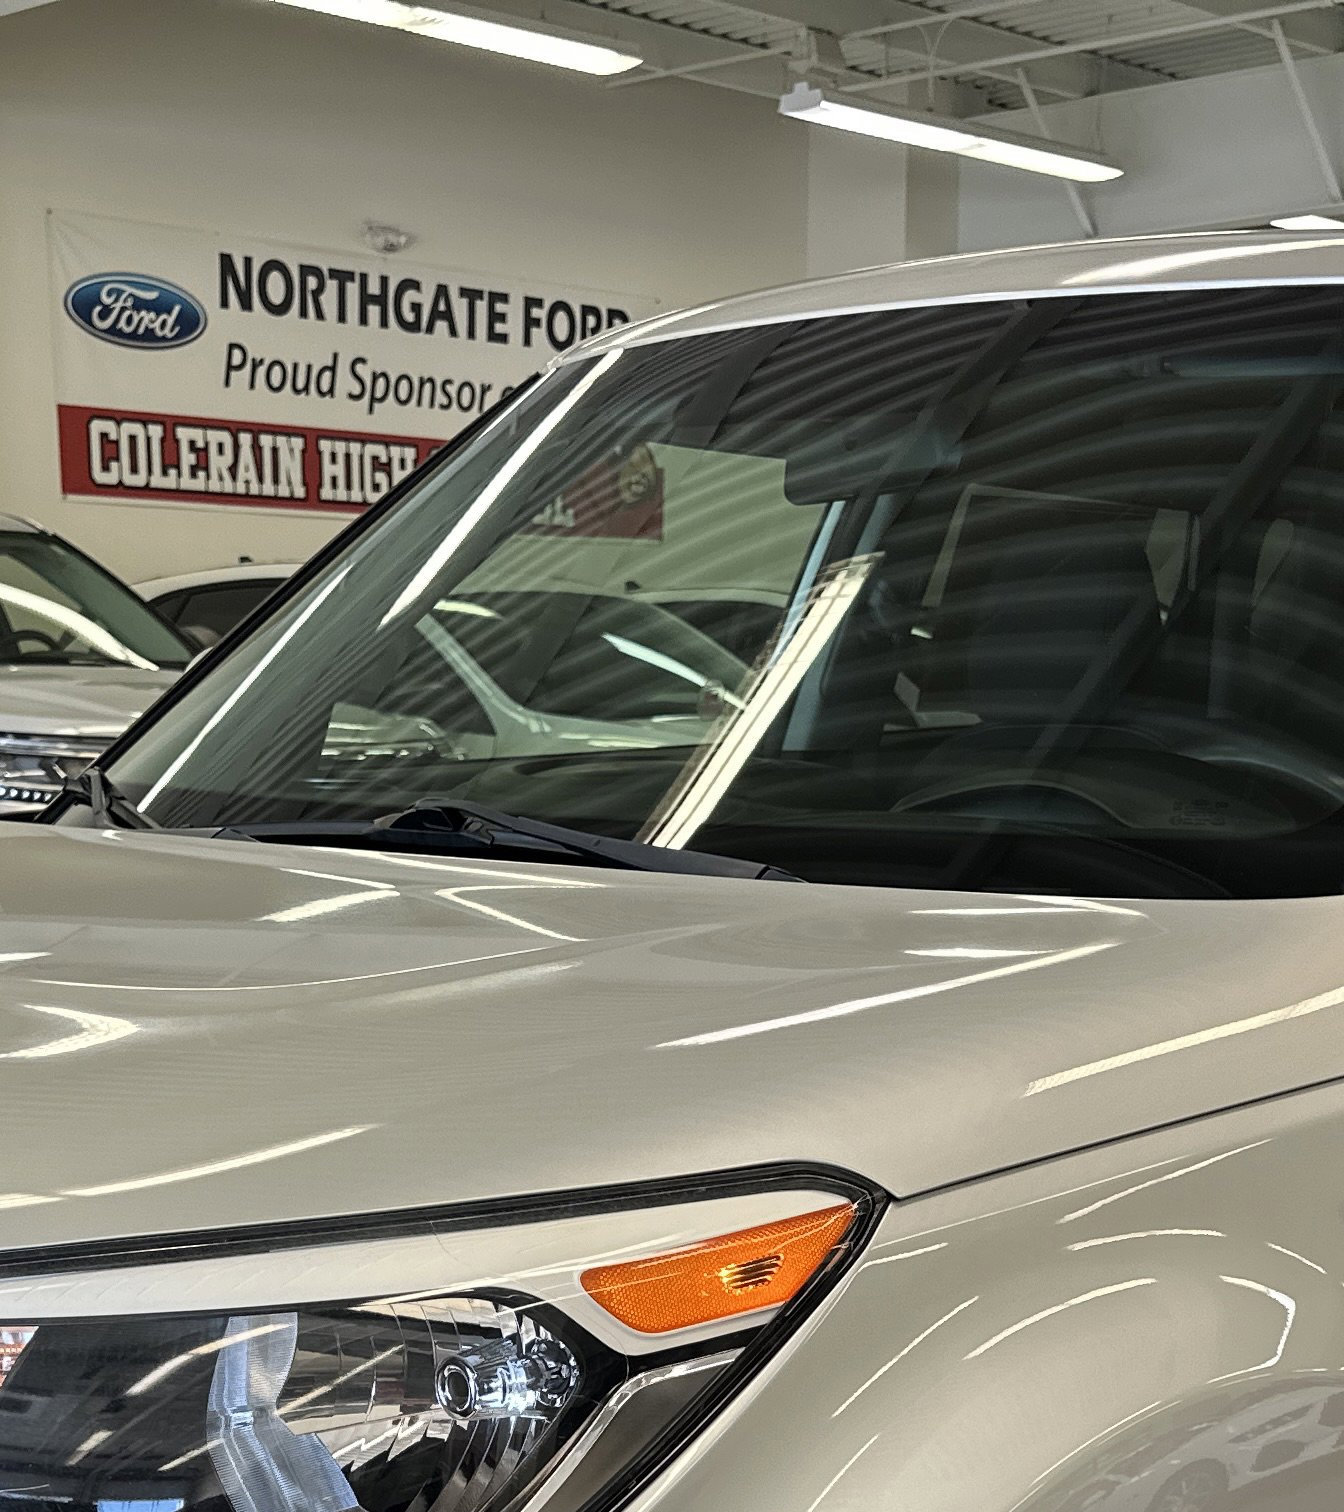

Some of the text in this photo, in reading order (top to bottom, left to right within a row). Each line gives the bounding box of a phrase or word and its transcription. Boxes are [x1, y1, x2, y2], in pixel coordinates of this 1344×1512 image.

[91, 282, 183, 340] Ford
[217, 252, 510, 345] NORTHGATE
[223, 343, 493, 415] Proud Sponsor
[87, 416, 308, 501] COLERAIN
